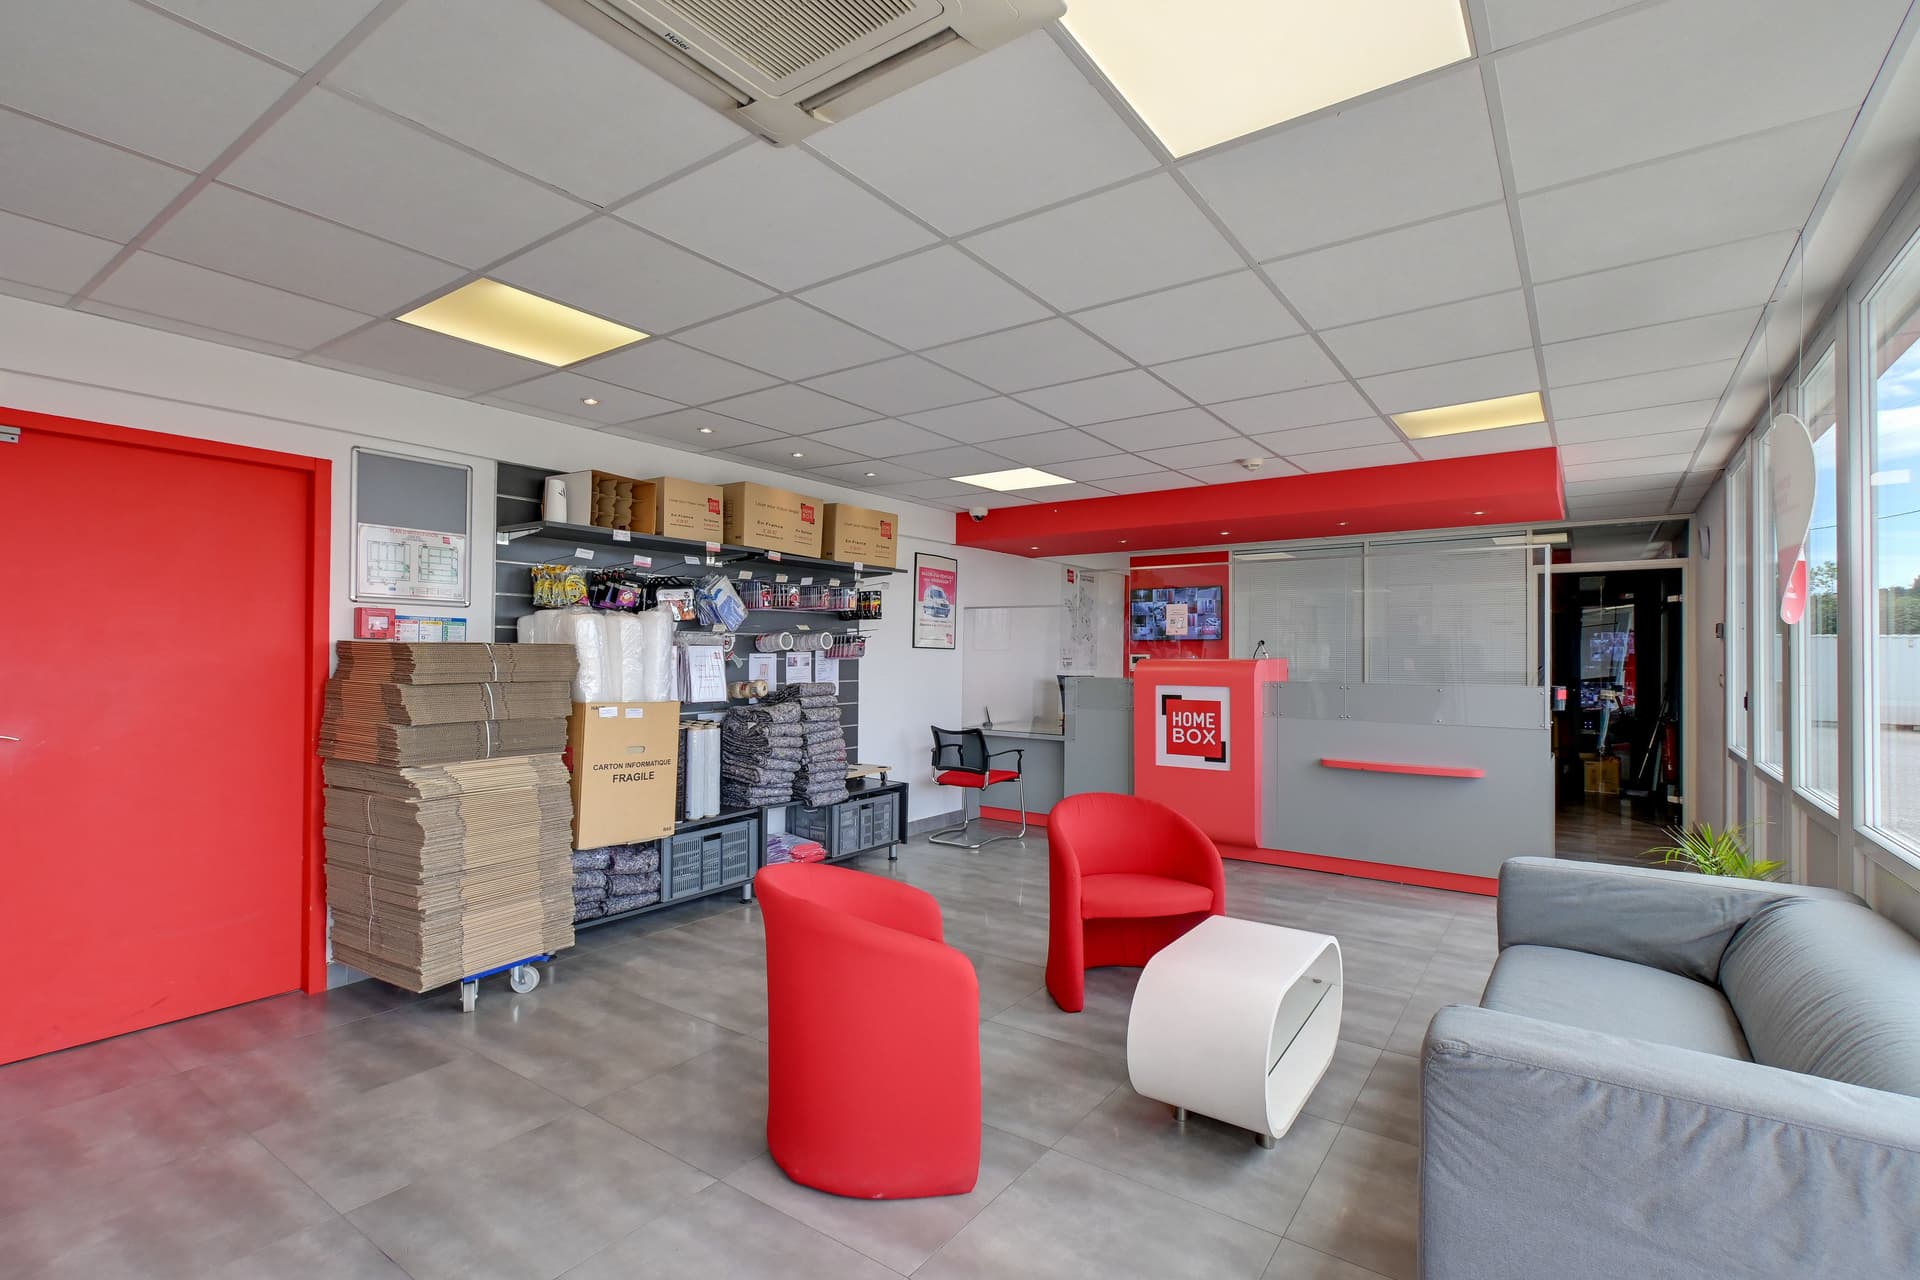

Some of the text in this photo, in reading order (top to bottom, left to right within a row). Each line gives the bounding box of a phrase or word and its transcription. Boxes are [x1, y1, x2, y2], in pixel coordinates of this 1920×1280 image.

[664, 32, 689, 50] Haier
[765, 521, 783, 529] France
[1172, 711, 1216, 728] HOME
[1172, 728, 1216, 745] BOX
[593, 759, 671, 771] CARTON INFORMATIQUE
[612, 771, 655, 783] FRAGILE
